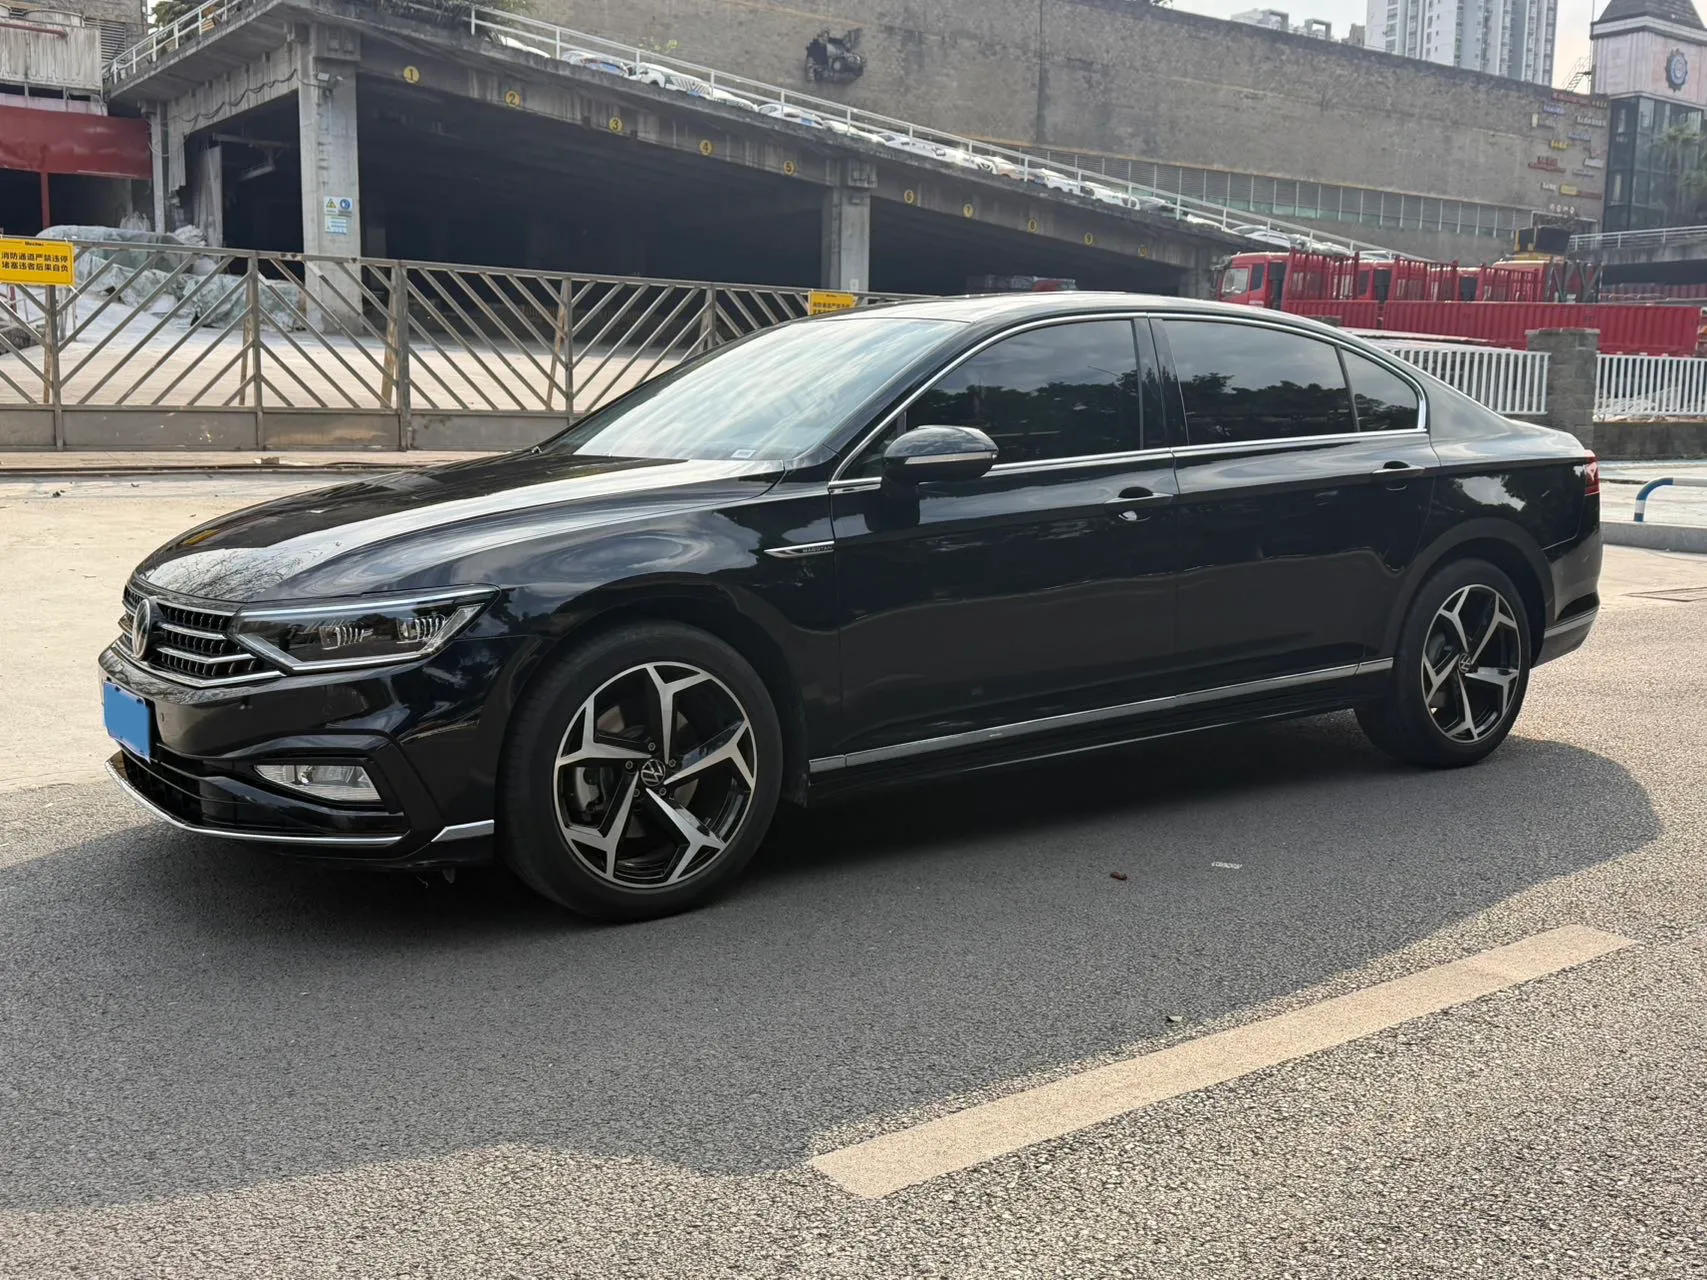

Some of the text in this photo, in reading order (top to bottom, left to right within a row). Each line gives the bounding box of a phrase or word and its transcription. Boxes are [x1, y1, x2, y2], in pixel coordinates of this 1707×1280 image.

[508, 92, 516, 105] 2
[612, 119, 619, 131] 3
[702, 142, 709, 153] 4
[1, 251, 68, 263] 消防通道严禁违停
[1, 261, 68, 273] 堵塞违者后果自负
